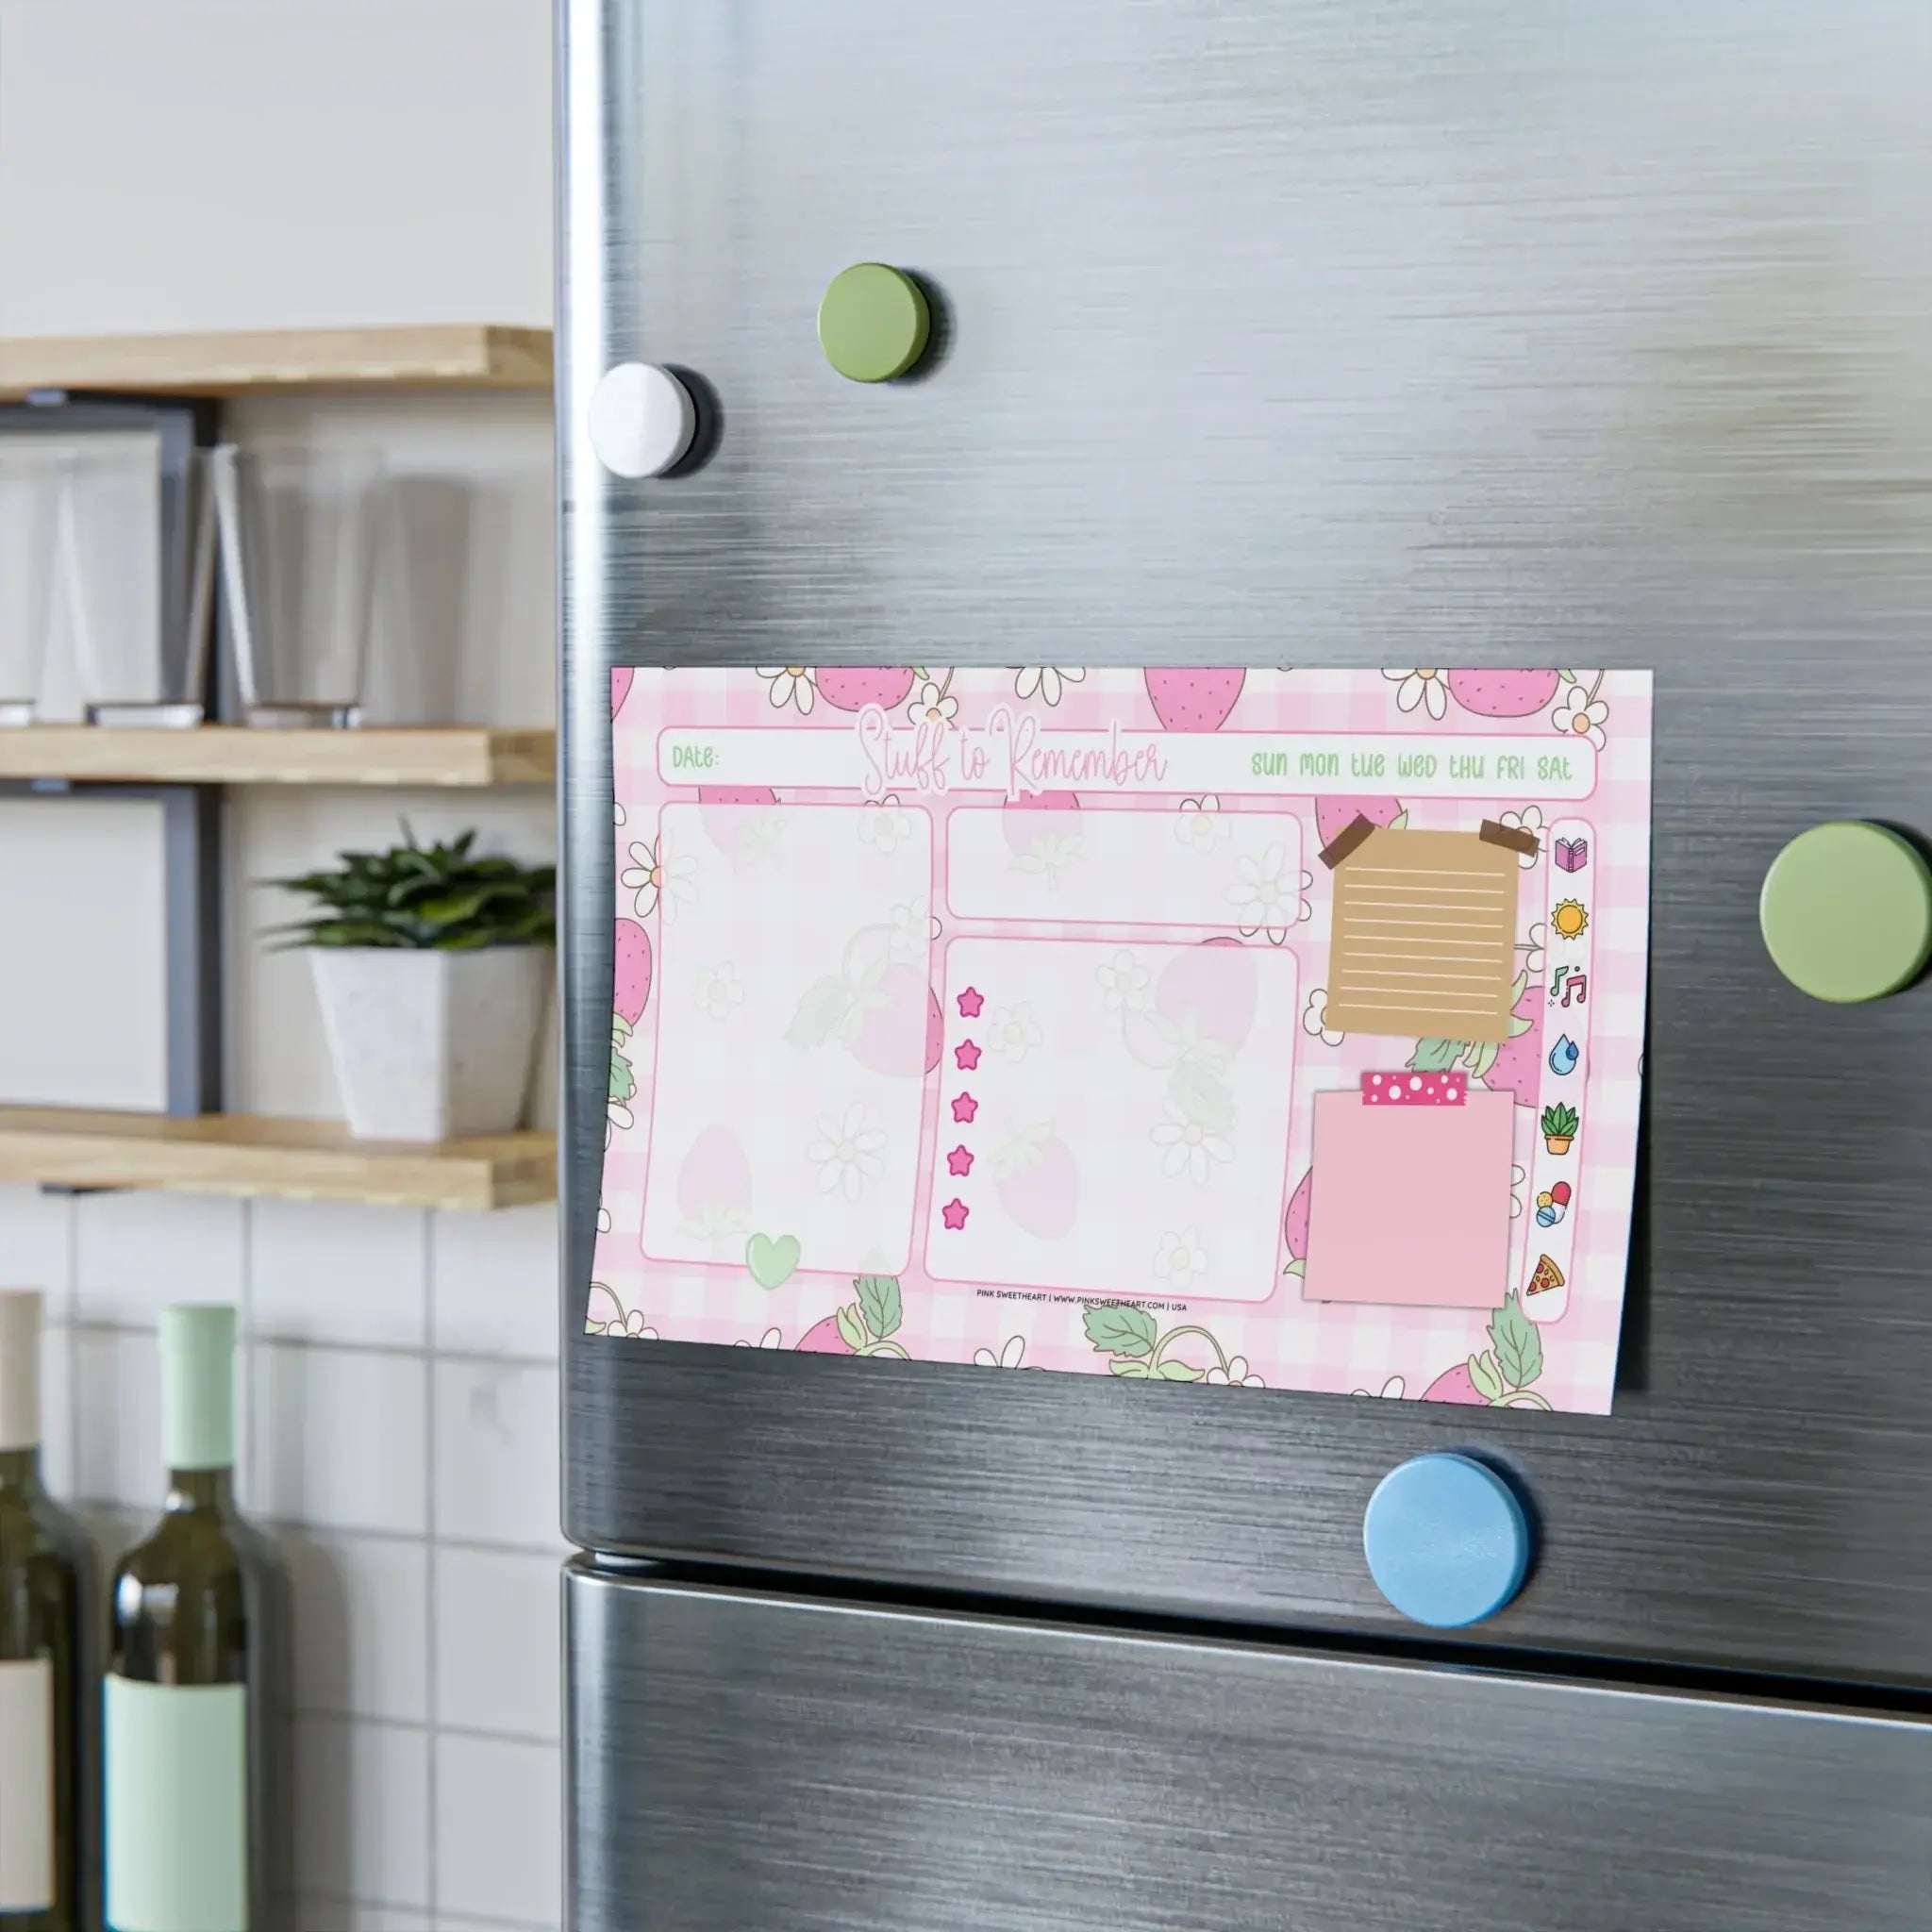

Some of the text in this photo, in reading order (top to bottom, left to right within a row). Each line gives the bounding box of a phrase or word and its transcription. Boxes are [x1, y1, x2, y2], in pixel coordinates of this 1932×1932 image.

[858, 708, 1168, 795] Stuff to Remember
[1496, 755, 1525, 780] FRI
[976, 1289, 995, 1298] PINK
[996, 1291, 1048, 1302] SWEETHEART
[1053, 1295, 1165, 1310] WWW.PINKSWEETHEART.COM
[1171, 1303, 1188, 1312] USA
